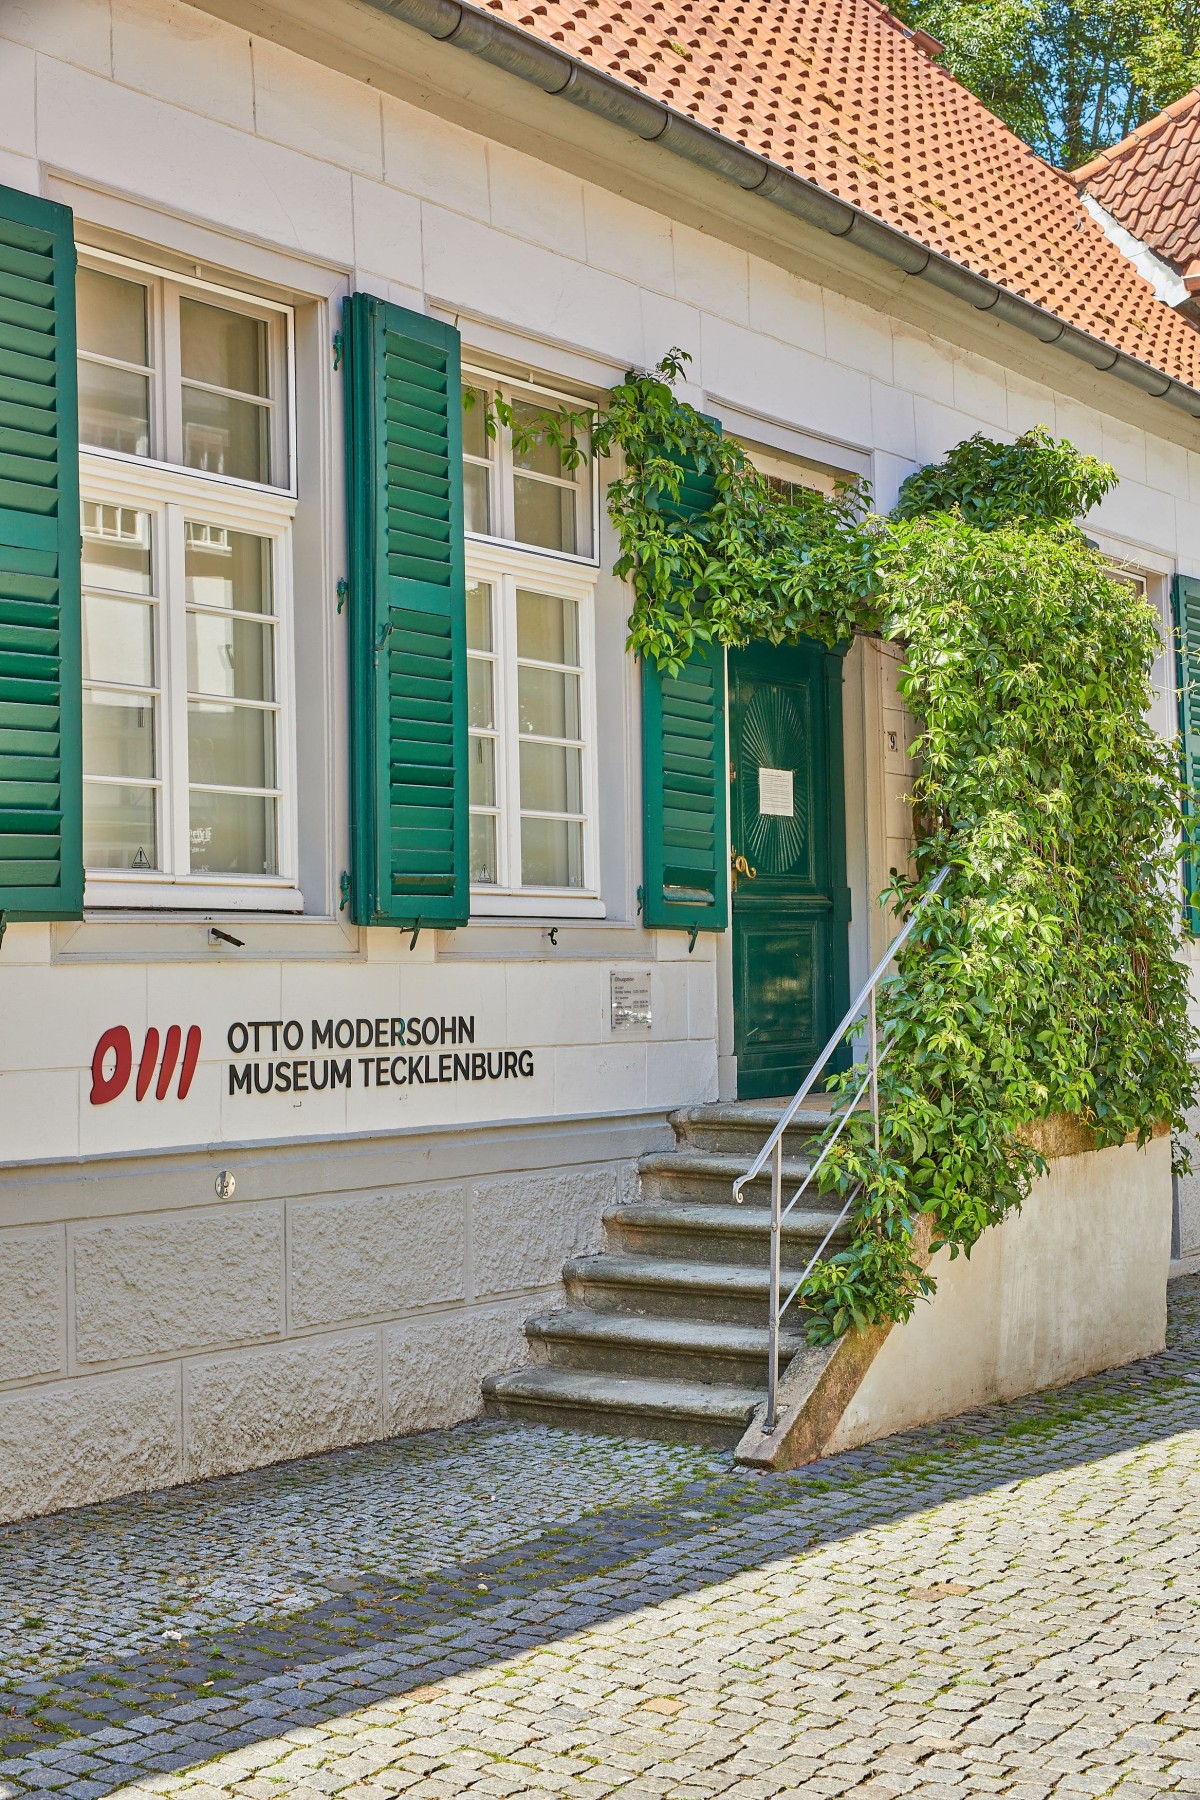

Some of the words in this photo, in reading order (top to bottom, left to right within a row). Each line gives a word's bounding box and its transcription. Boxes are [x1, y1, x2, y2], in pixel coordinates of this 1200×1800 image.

[890, 734, 896, 750] 9
[227, 1020, 304, 1053] OTTO
[311, 1016, 475, 1049] MODERSOHN
[229, 1059, 352, 1095] MUSEUM
[358, 1050, 534, 1087] TECKLENBURG
